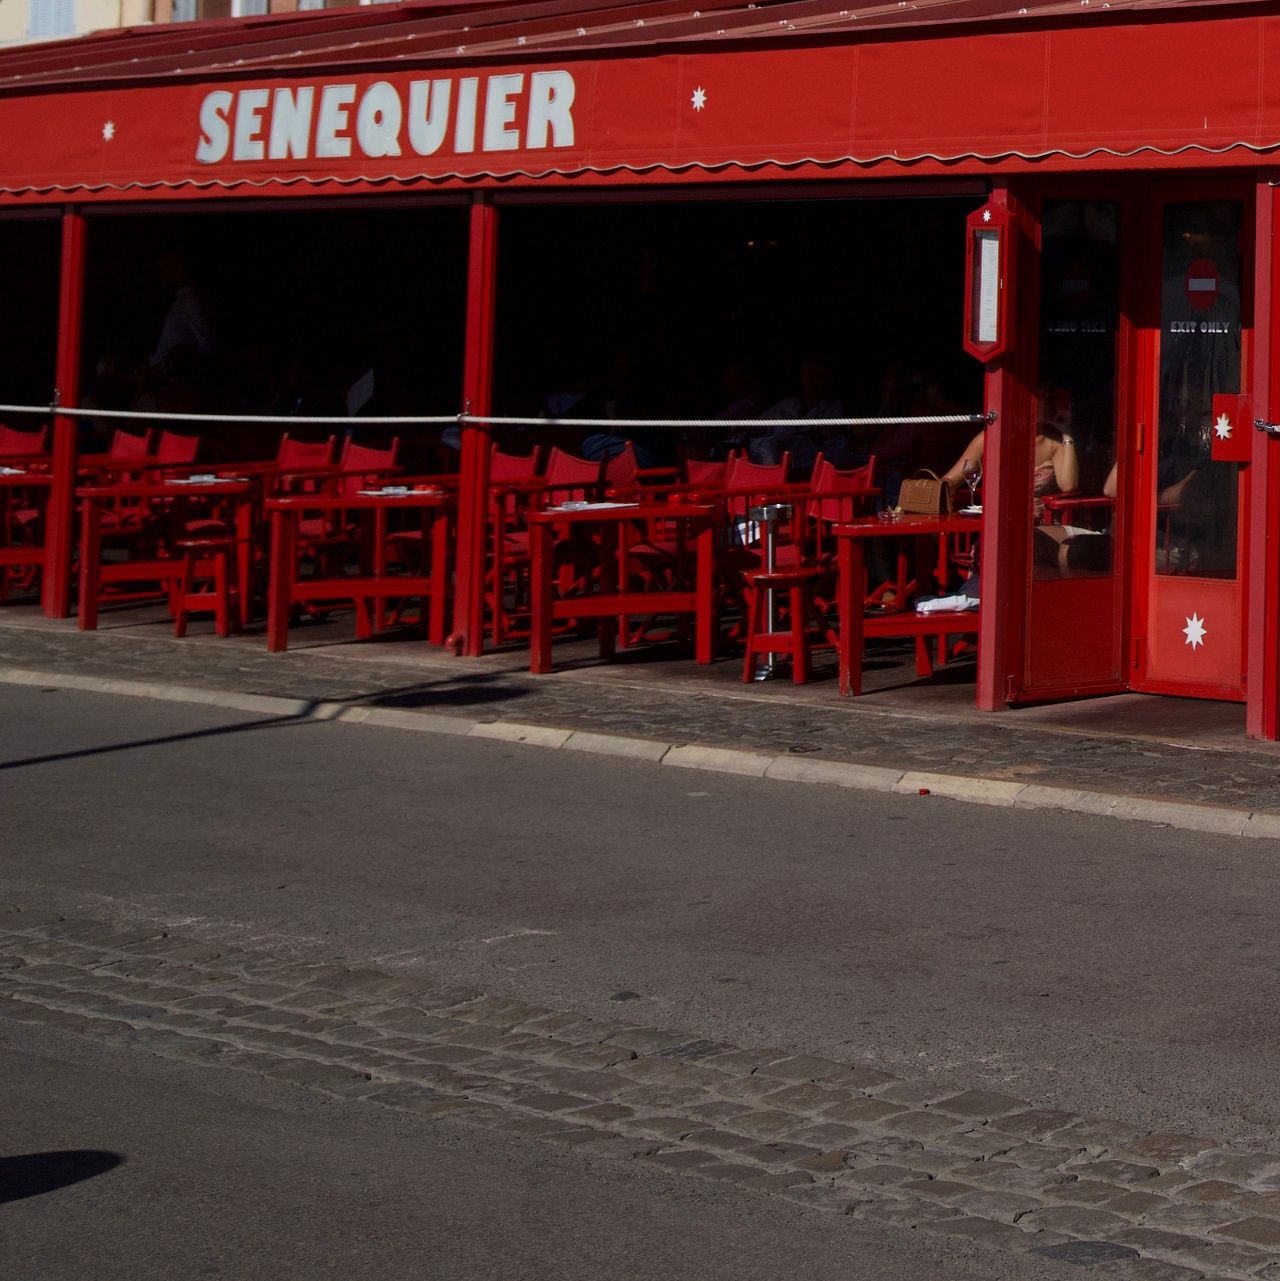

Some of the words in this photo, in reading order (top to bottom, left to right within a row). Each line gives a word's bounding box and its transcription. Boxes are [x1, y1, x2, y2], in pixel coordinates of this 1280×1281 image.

[195, 70, 577, 163] SENEQUIER
[1170, 320, 1197, 333] EXIT
[1200, 321, 1230, 334] ONLY
